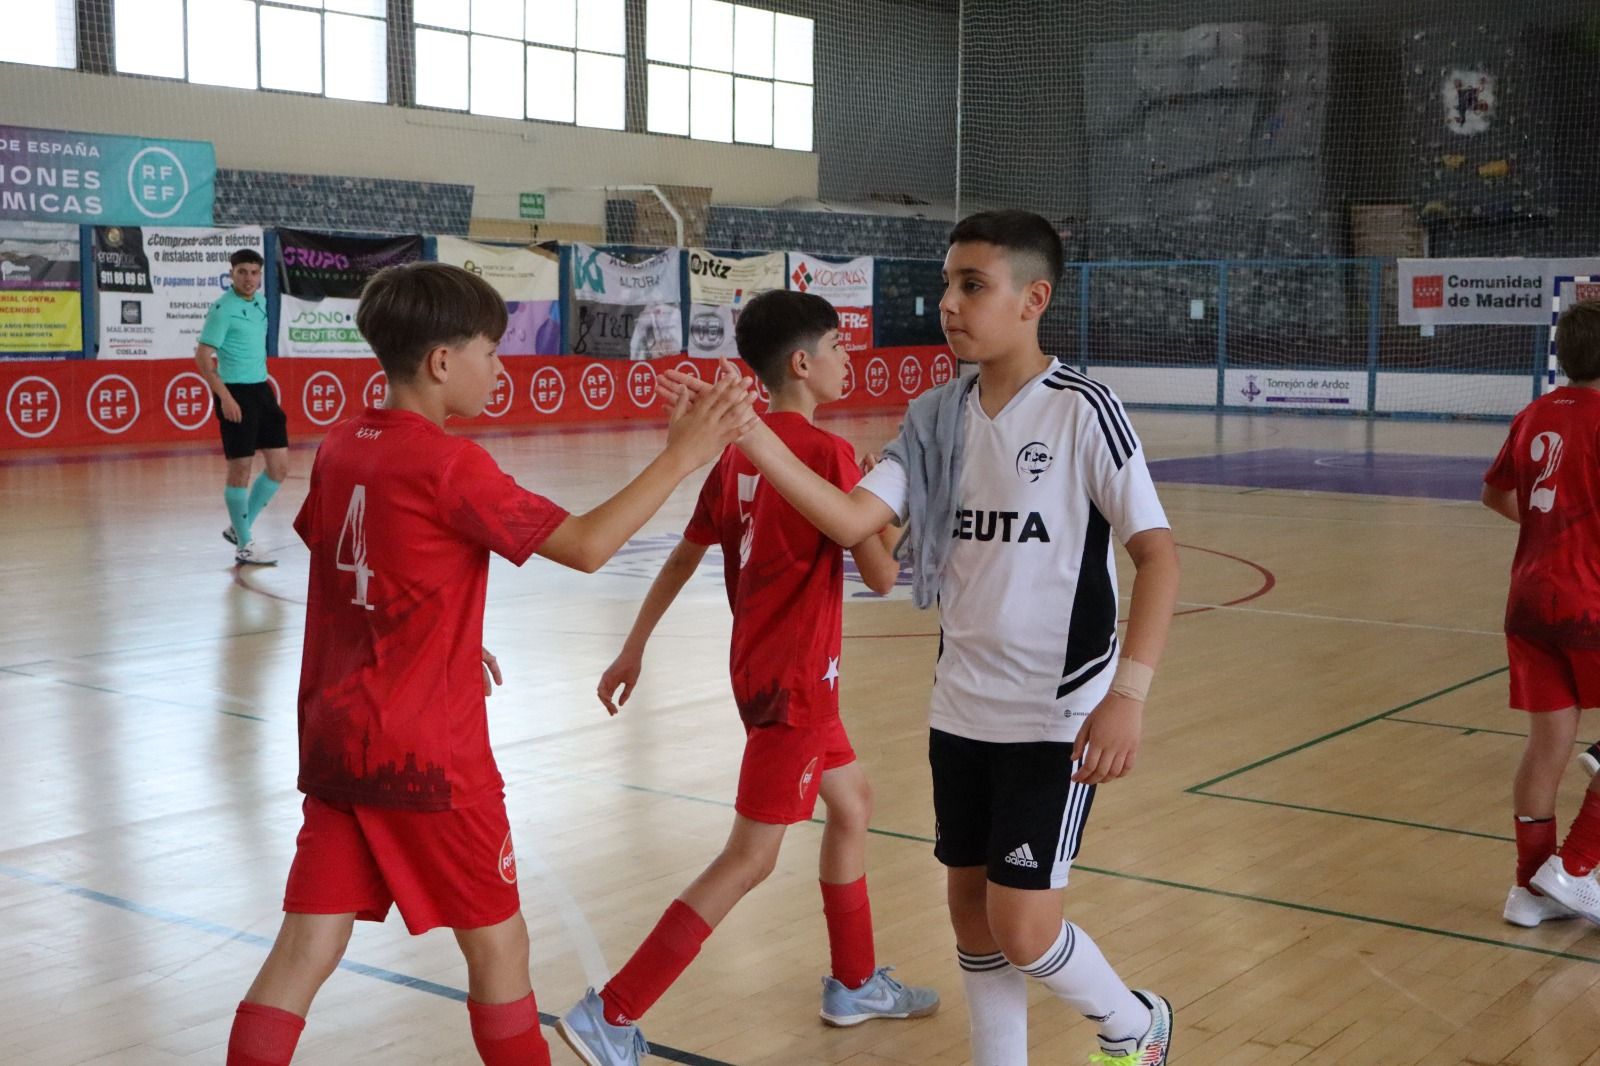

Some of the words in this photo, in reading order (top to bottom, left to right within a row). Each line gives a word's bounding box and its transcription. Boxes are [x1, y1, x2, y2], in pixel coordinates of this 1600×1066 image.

[28, 141, 99, 157] ESPAÑA
[142, 164, 173, 180] RF
[143, 185, 175, 201] EF
[2, 191, 103, 215] MICAS
[284, 246, 350, 271] GRUPO
[690, 253, 732, 279] Ortiz
[1448, 274, 1542, 289] Comunidad
[1448, 293, 1470, 308] de
[1476, 293, 1543, 308] Madrid
[292, 329, 346, 340] CENTRO
[1266, 378, 1305, 391] Torrejón
[1307, 379, 1319, 389] de
[1322, 379, 1350, 390] Ardoz
[1528, 431, 1564, 514] 2
[737, 472, 761, 570] 5
[336, 484, 375, 610] 4
[1004, 855, 1039, 869] adidas
